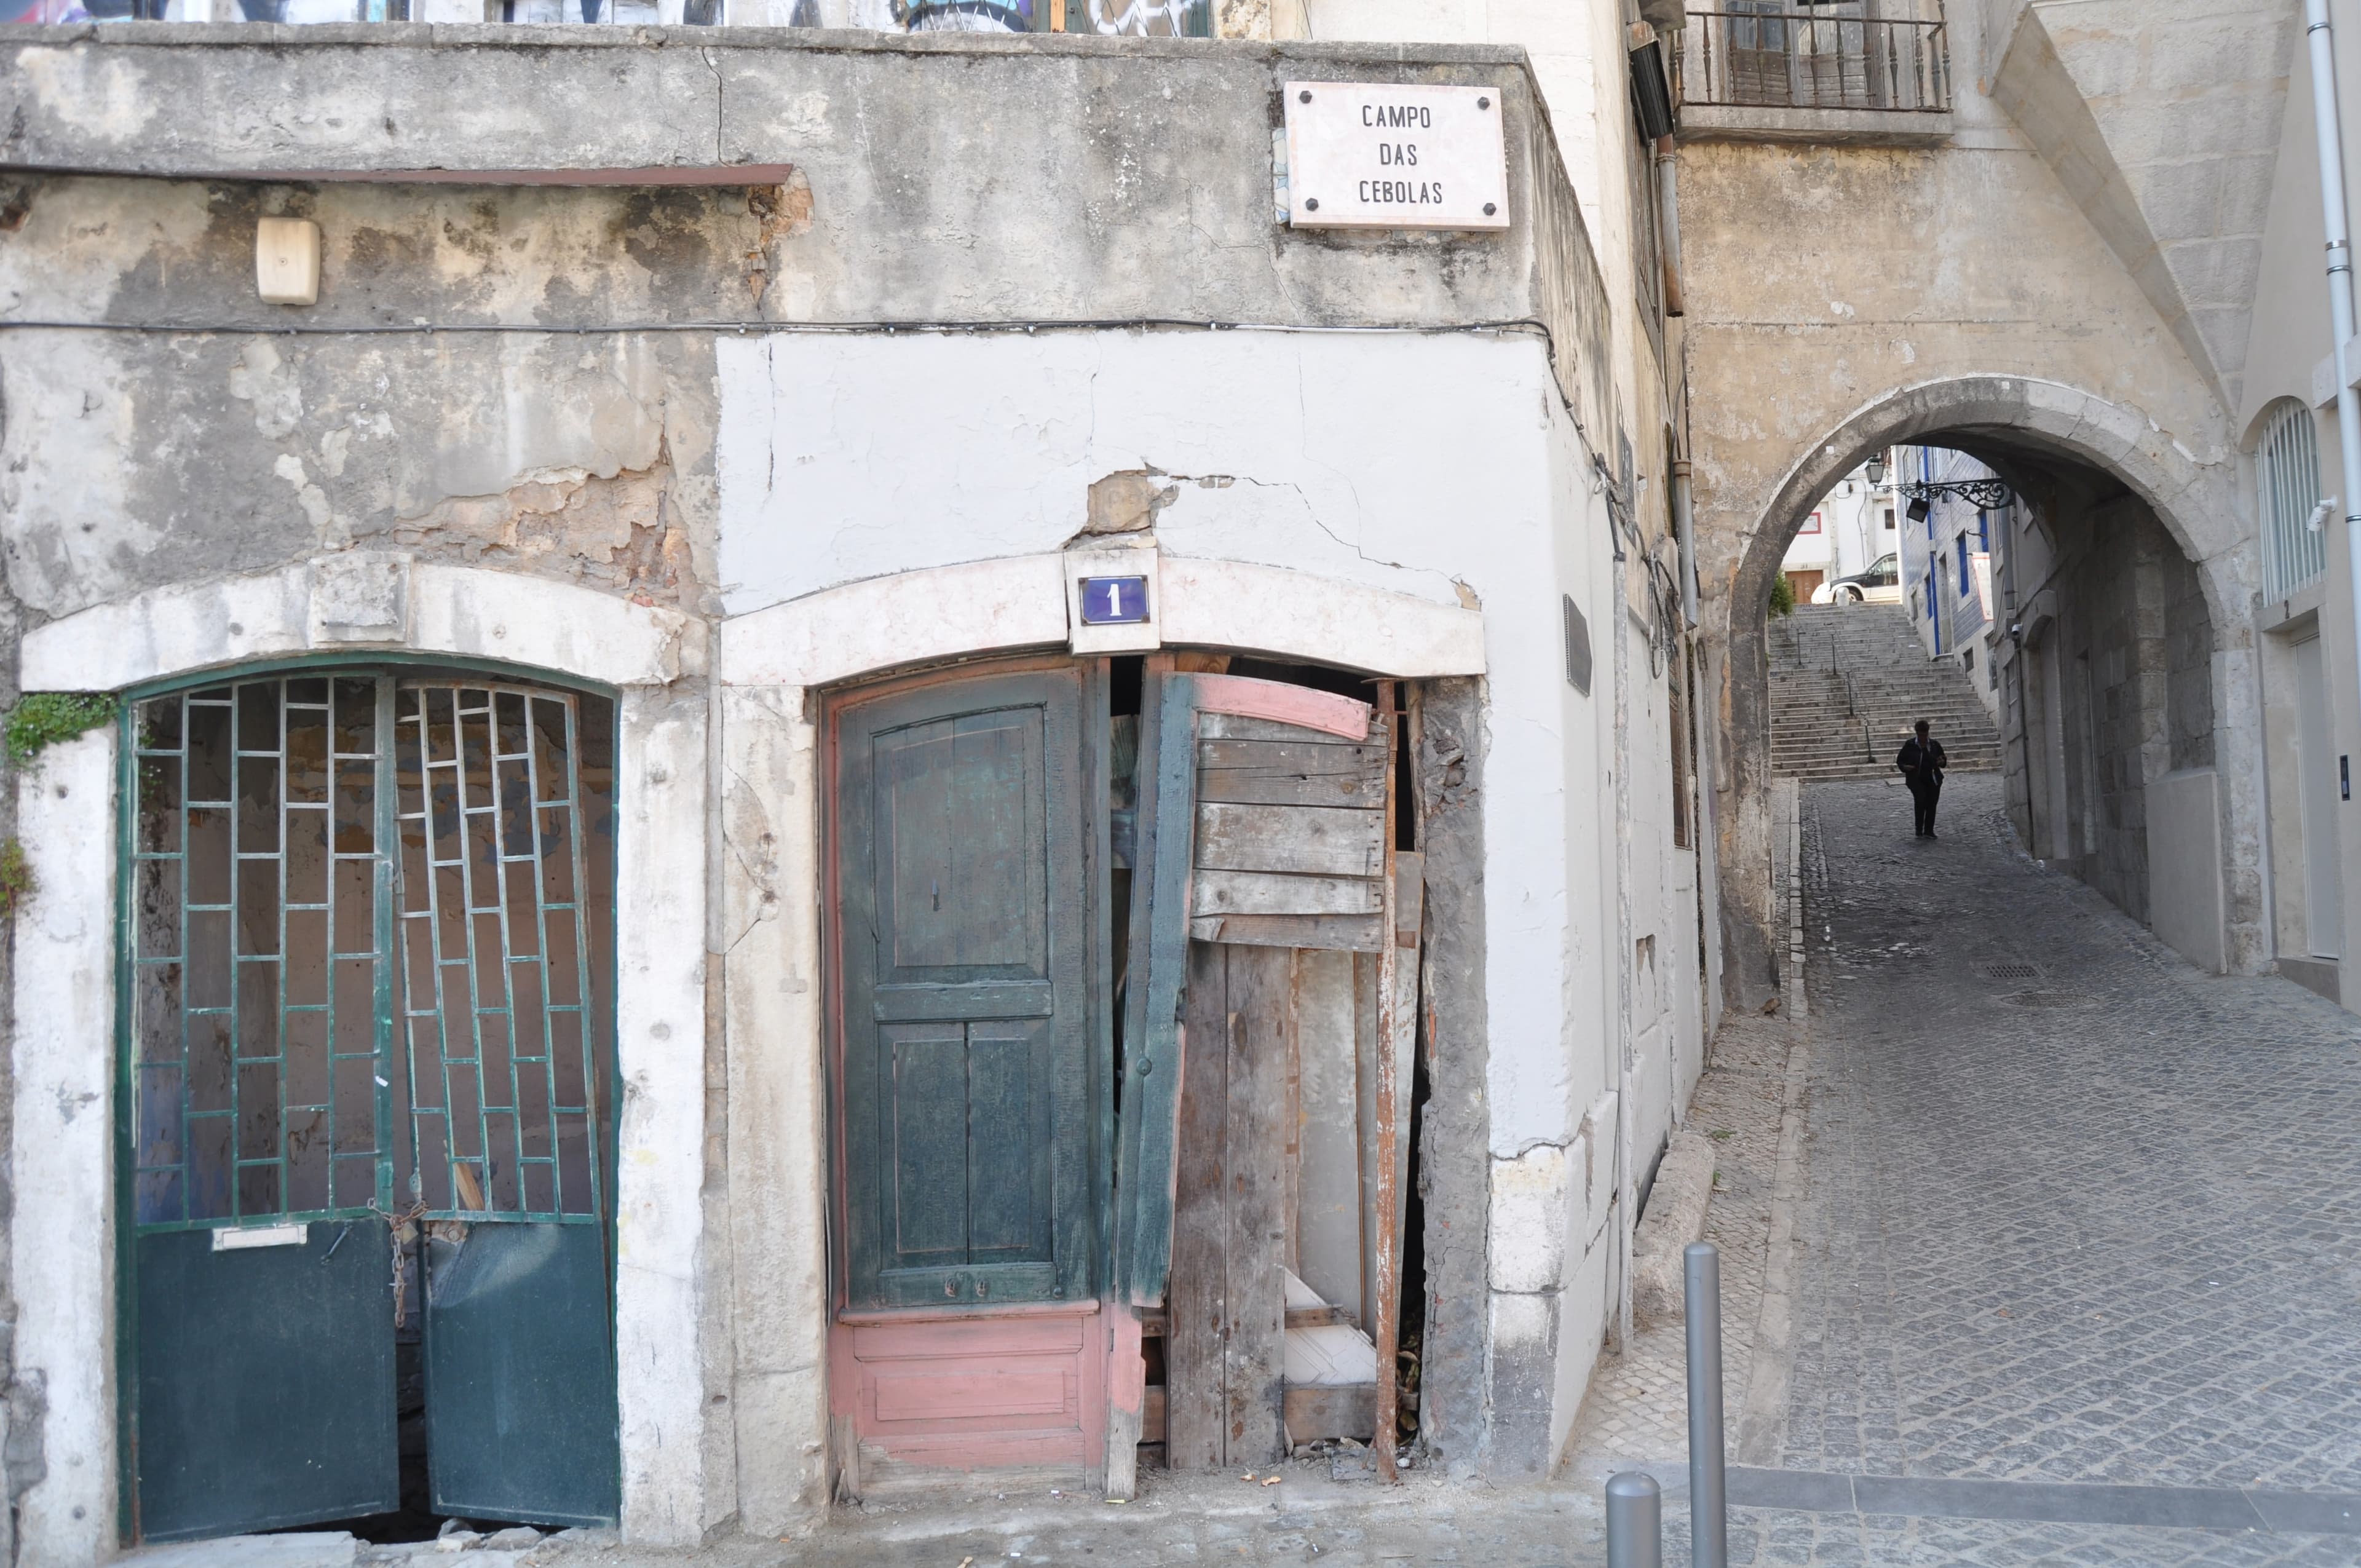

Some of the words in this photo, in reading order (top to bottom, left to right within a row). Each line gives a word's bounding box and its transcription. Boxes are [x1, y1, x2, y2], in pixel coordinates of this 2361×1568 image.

[1362, 105, 1431, 129] CAMPO
[1380, 143, 1417, 165] DAS
[1359, 180, 1442, 204] CEBOLAS
[1107, 584, 1121, 616] 1
